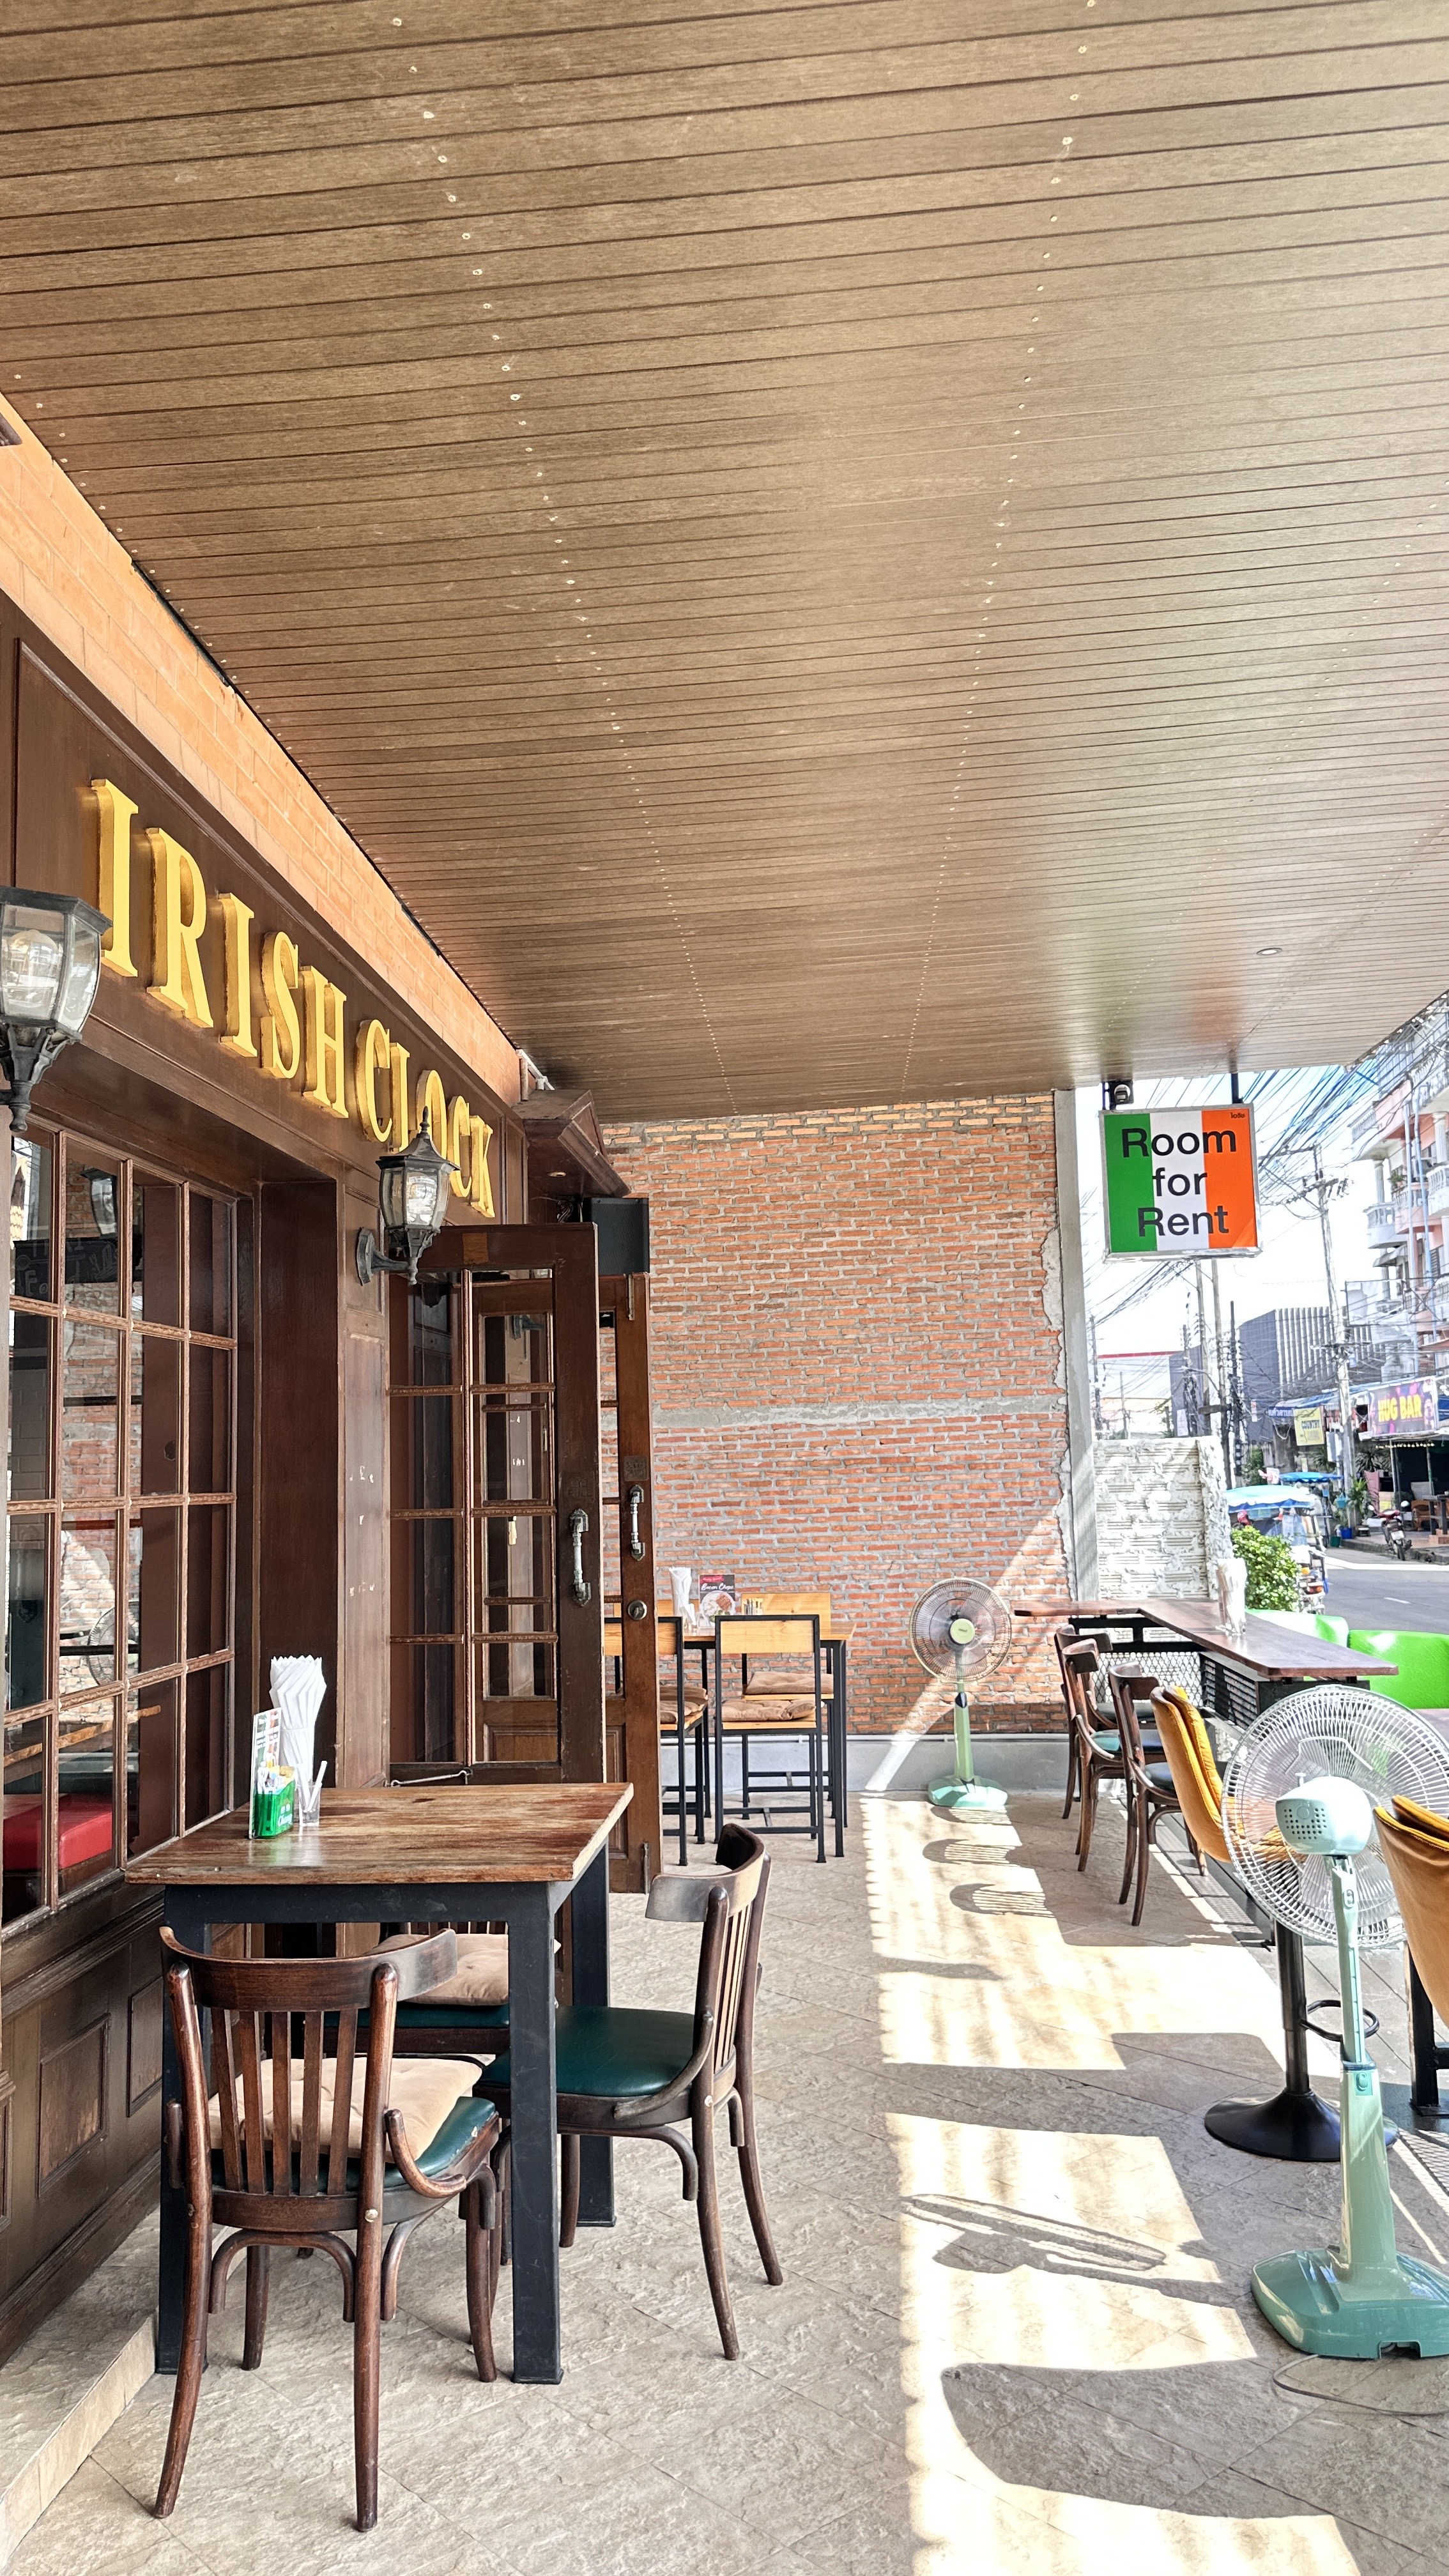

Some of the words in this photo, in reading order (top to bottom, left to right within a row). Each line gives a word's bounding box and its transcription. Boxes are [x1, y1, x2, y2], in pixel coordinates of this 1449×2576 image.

[91, 778, 349, 1118] IRISH
[1121, 1128, 1237, 1158] Room
[1152, 1167, 1208, 1197] for
[1137, 1205, 1229, 1237] Rent
[1399, 1394, 1423, 1420] BAR
